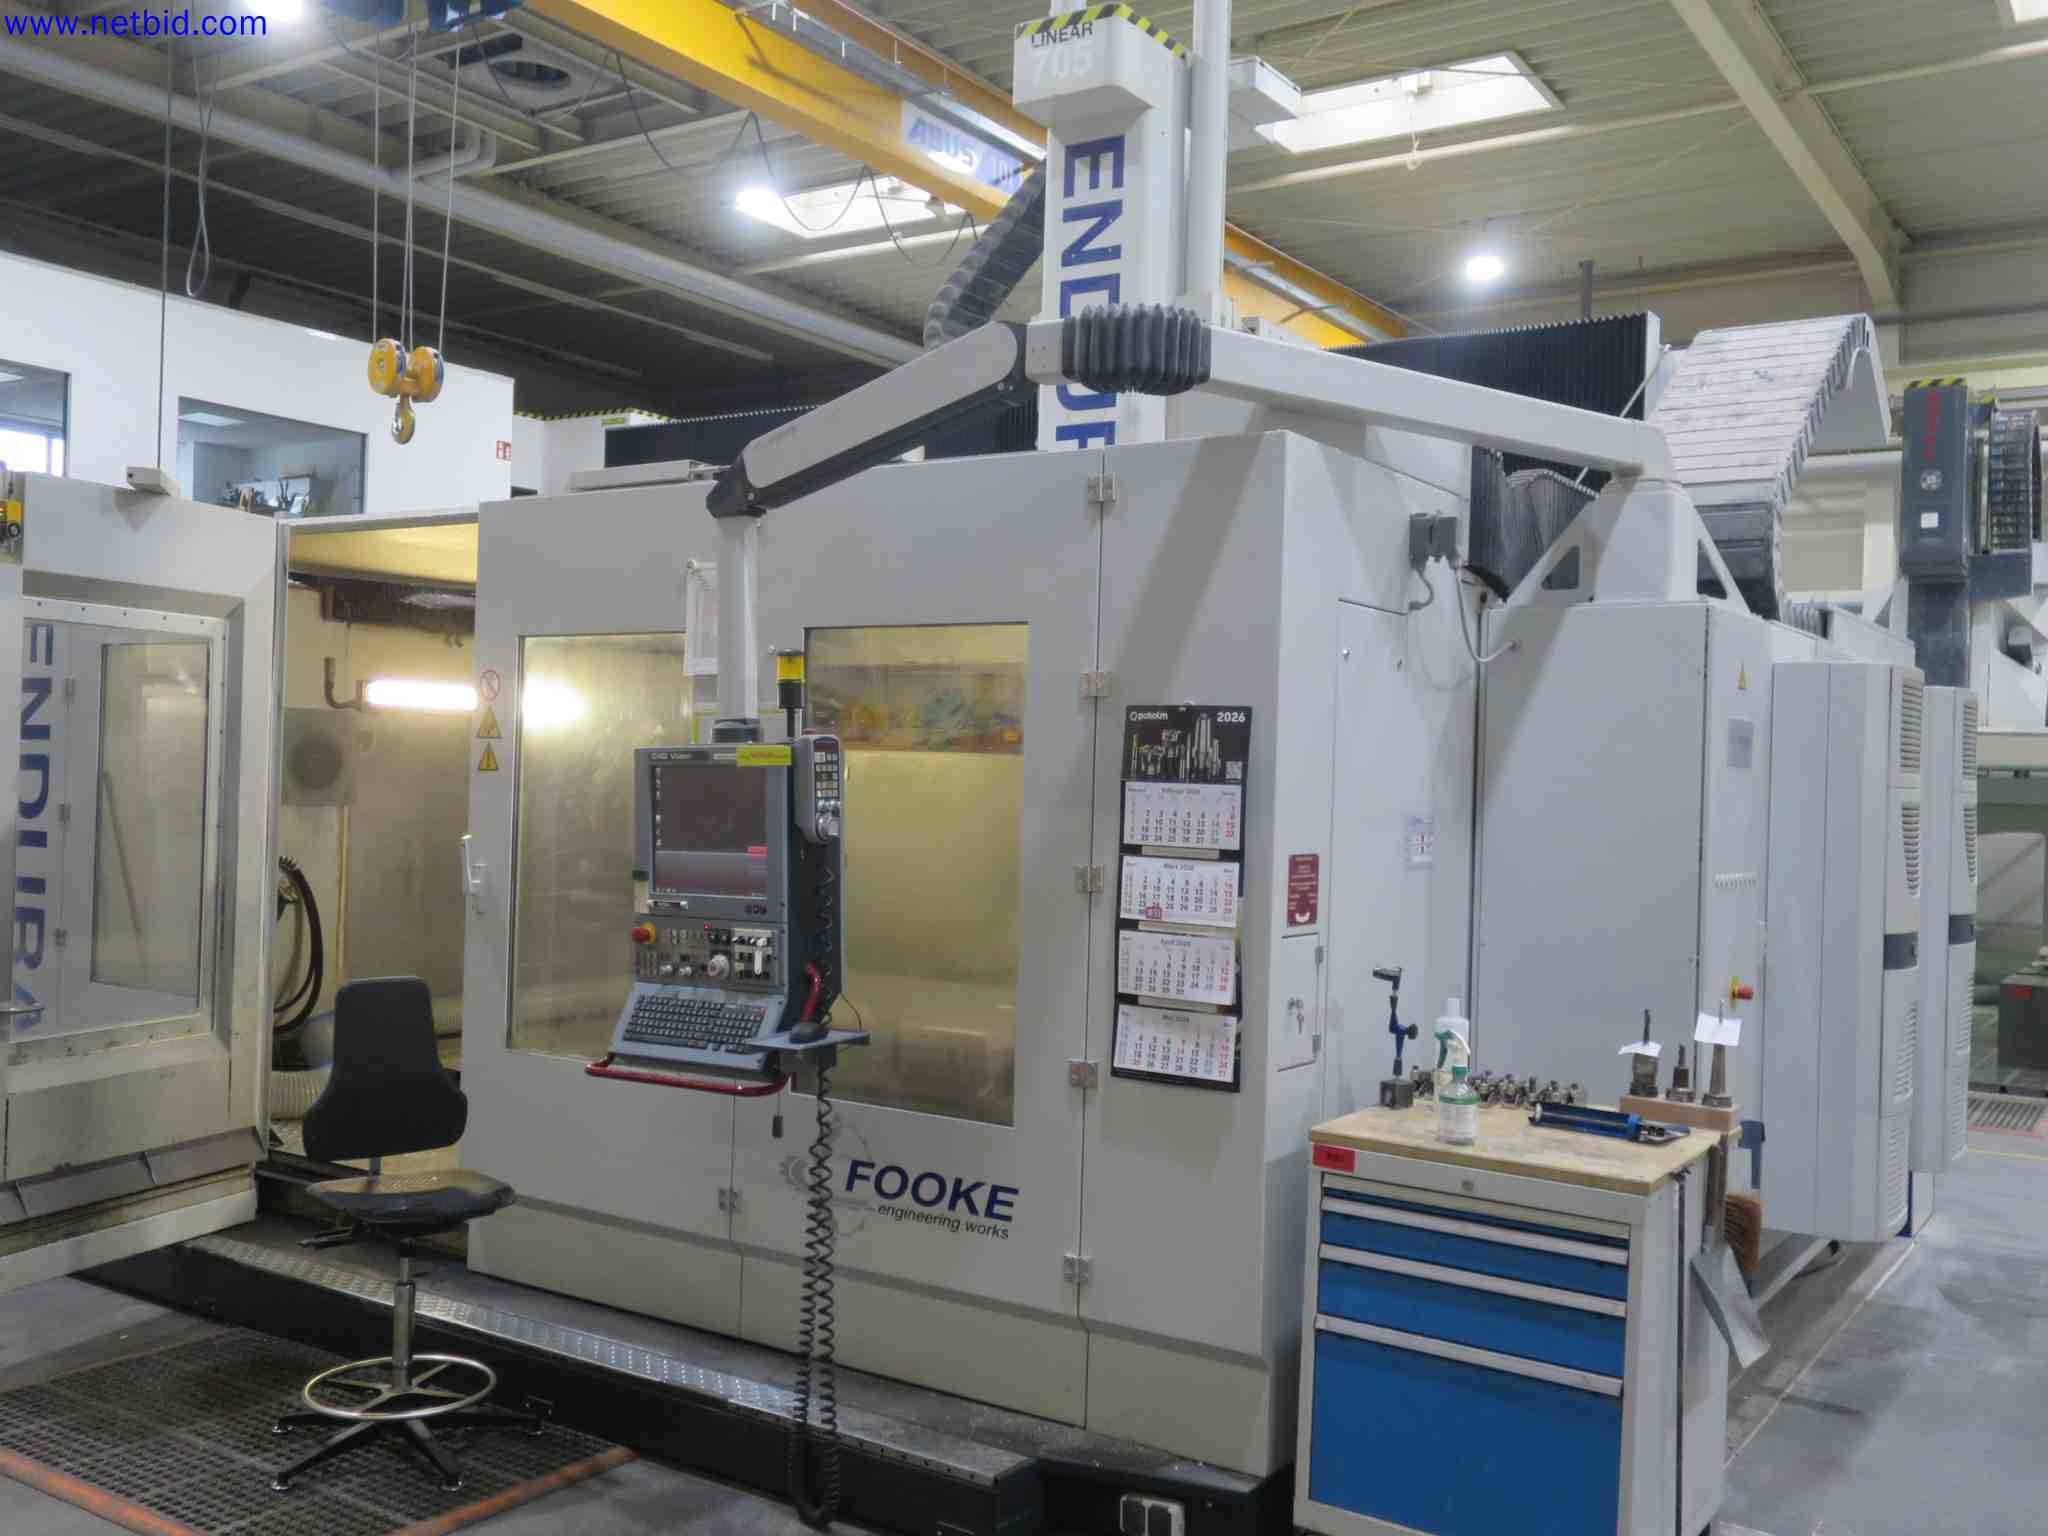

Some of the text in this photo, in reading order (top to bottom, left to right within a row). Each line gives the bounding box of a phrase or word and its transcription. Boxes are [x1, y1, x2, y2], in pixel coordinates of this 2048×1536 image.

[1031, 20, 1093, 48] LINEAR
[1031, 49, 1092, 88] 705
[908, 117, 977, 168] ABUS
[1217, 711, 1246, 722] 2026
[845, 1159, 1019, 1223] FOOKE
[877, 1204, 1009, 1240] engineering works
